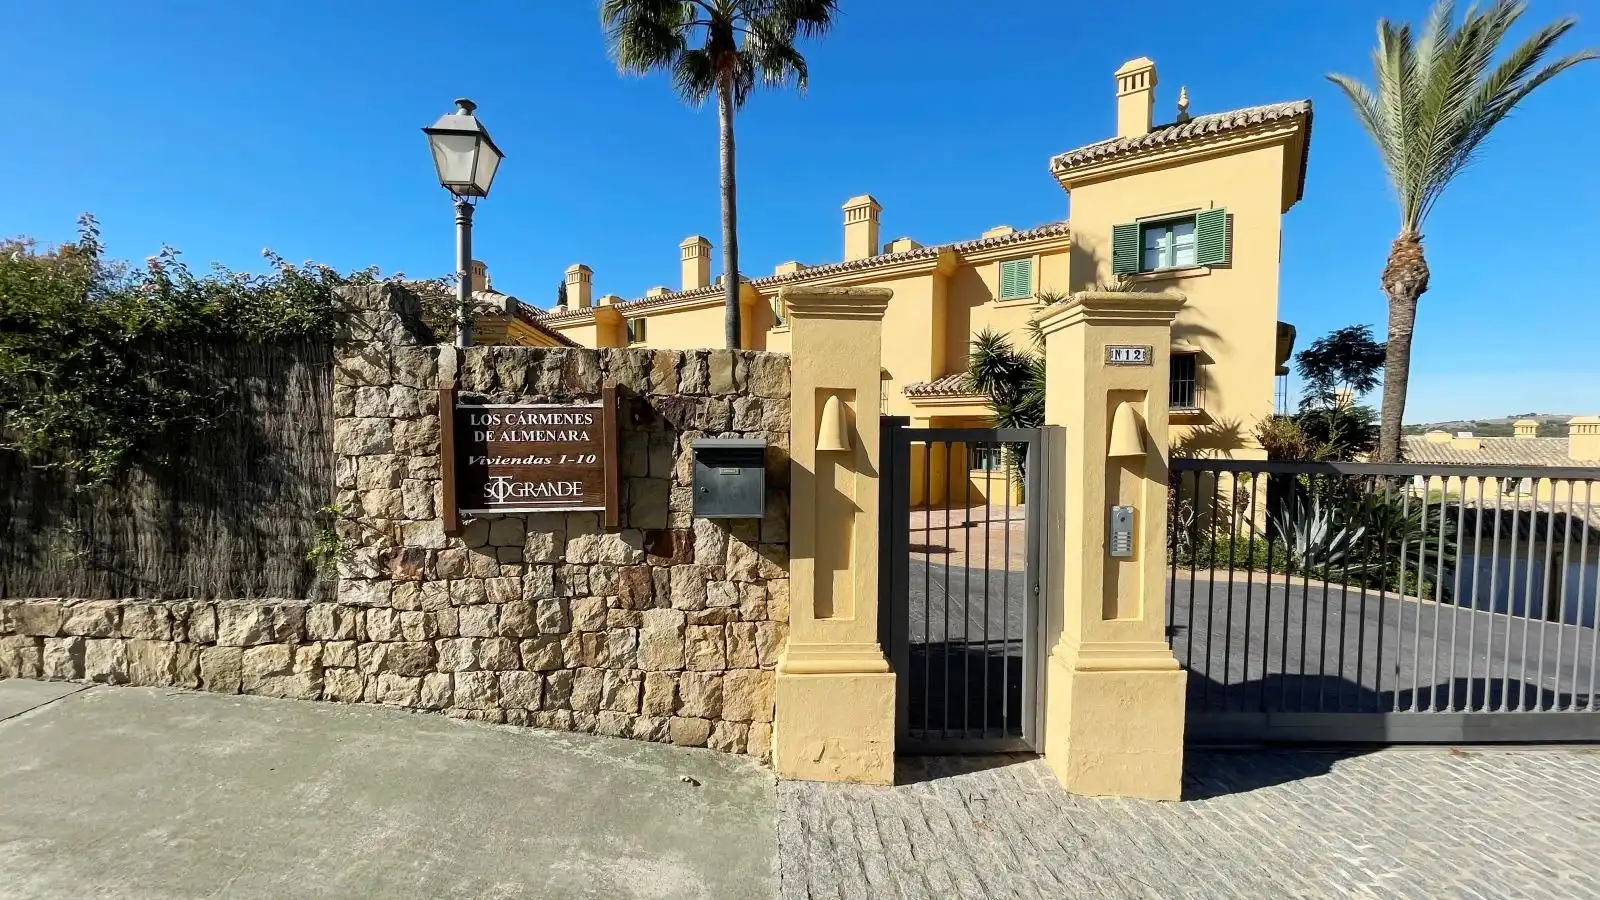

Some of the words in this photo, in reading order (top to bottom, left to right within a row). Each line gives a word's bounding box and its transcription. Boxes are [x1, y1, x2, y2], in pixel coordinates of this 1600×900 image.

[470, 413, 501, 426] LOS
[505, 411, 593, 425] CÁRMENES
[474, 430, 495, 442] DE
[499, 430, 590, 442] ALMENARA
[468, 455, 552, 465] Viviendas
[558, 454, 597, 464] 1-10
